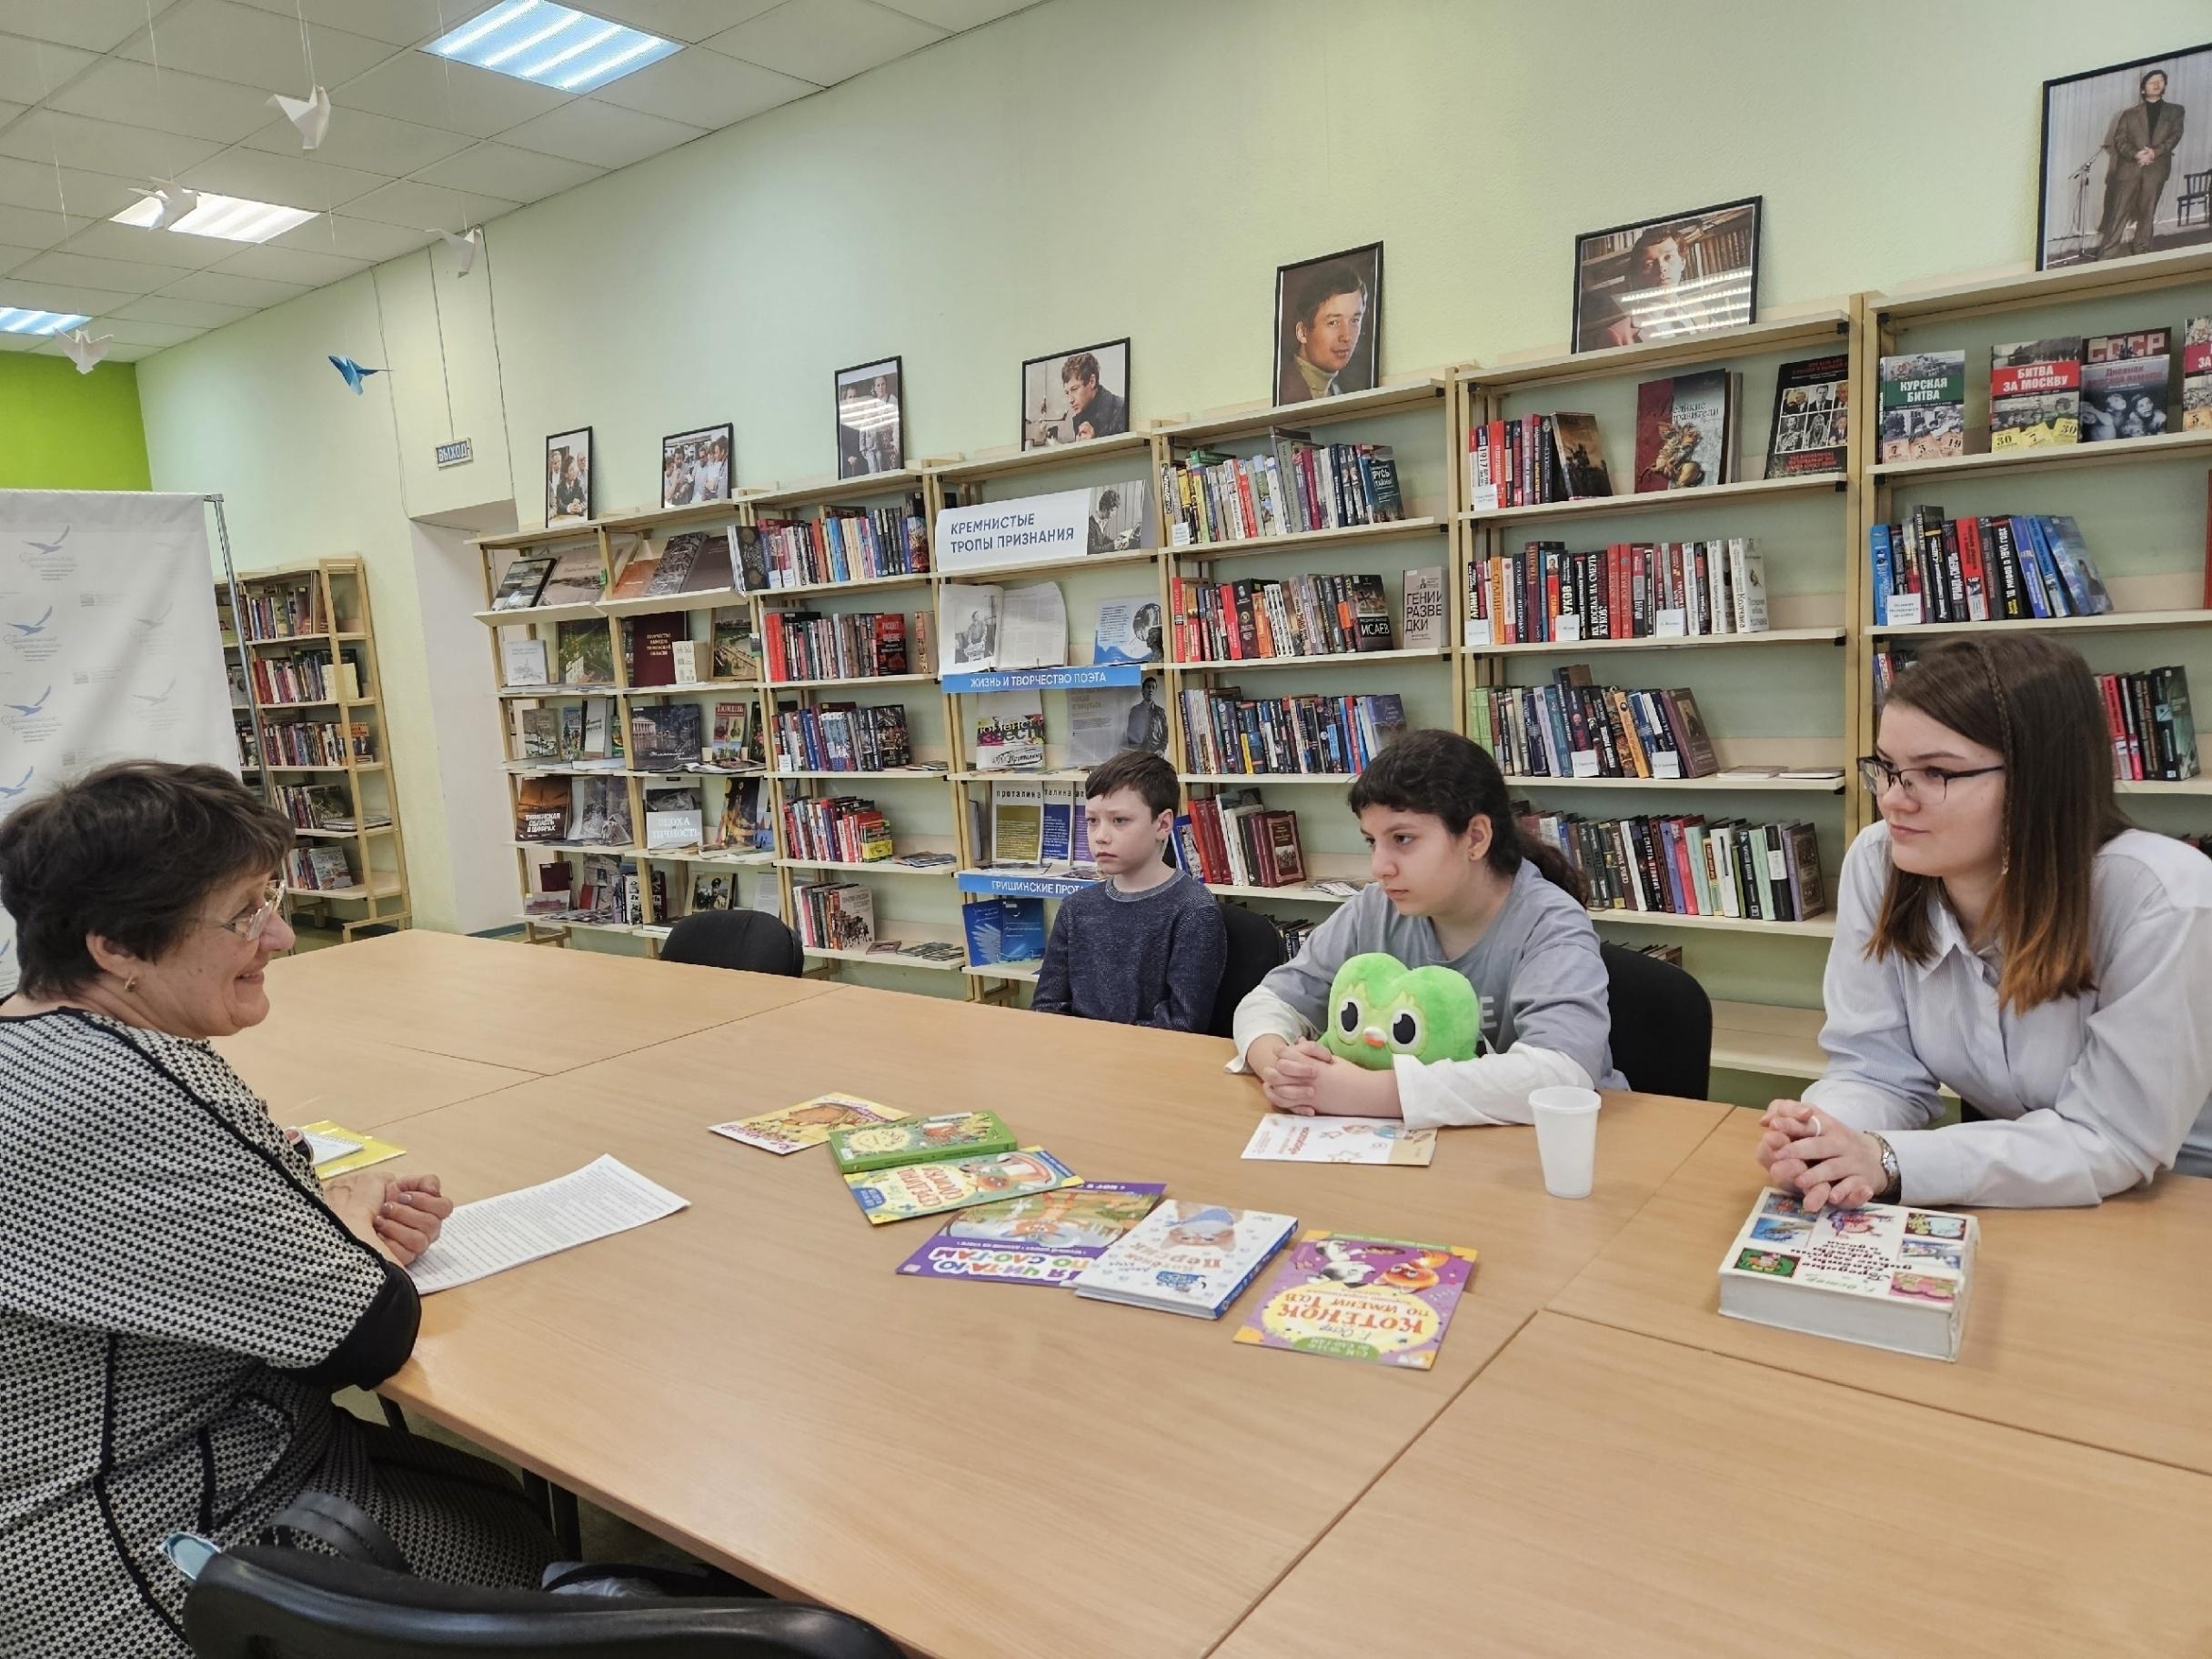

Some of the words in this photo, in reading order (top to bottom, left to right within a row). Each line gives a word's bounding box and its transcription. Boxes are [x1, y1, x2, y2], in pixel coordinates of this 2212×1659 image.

[2017, 365, 2054, 378] БИТВА
[1900, 377, 1947, 392] КУРСКАЯ
[2003, 380, 2018, 393] ЗА
[2021, 375, 2068, 389] МОСКВУ
[1907, 391, 1940, 402] БИТВА
[438, 444, 467, 462] ВЫХОД
[1373, 468, 1391, 479] РУСЬ
[950, 513, 1035, 535] КРЕМНИСТЫЕ
[950, 537, 993, 553] ТРОПЫ
[997, 528, 1074, 548] ПРИЗНАНИЯ
[1999, 545, 2012, 558] 1941
[1493, 572, 1502, 612] СТАЛИН
[1406, 604, 1442, 621] РАЗВЕ
[1361, 622, 1390, 636] ИСАЕВ
[1405, 618, 1429, 636] ДКИ
[970, 676, 1001, 689] ЖИЗНЬ
[1002, 676, 1010, 687] И
[1011, 674, 1071, 687] ТВОРЧЕСТВО
[1074, 671, 1107, 683] ПОЭТА
[996, 789, 1041, 799] проталина
[991, 880, 1051, 893] ГРИШИНСКИЕ
[1052, 883, 1086, 895] ПРОТ
[931, 1248, 1047, 1265] СЛО-ГАМ
[1331, 1297, 1398, 1313] ИМЕНИ
[1407, 1306, 1430, 1318] ПО
